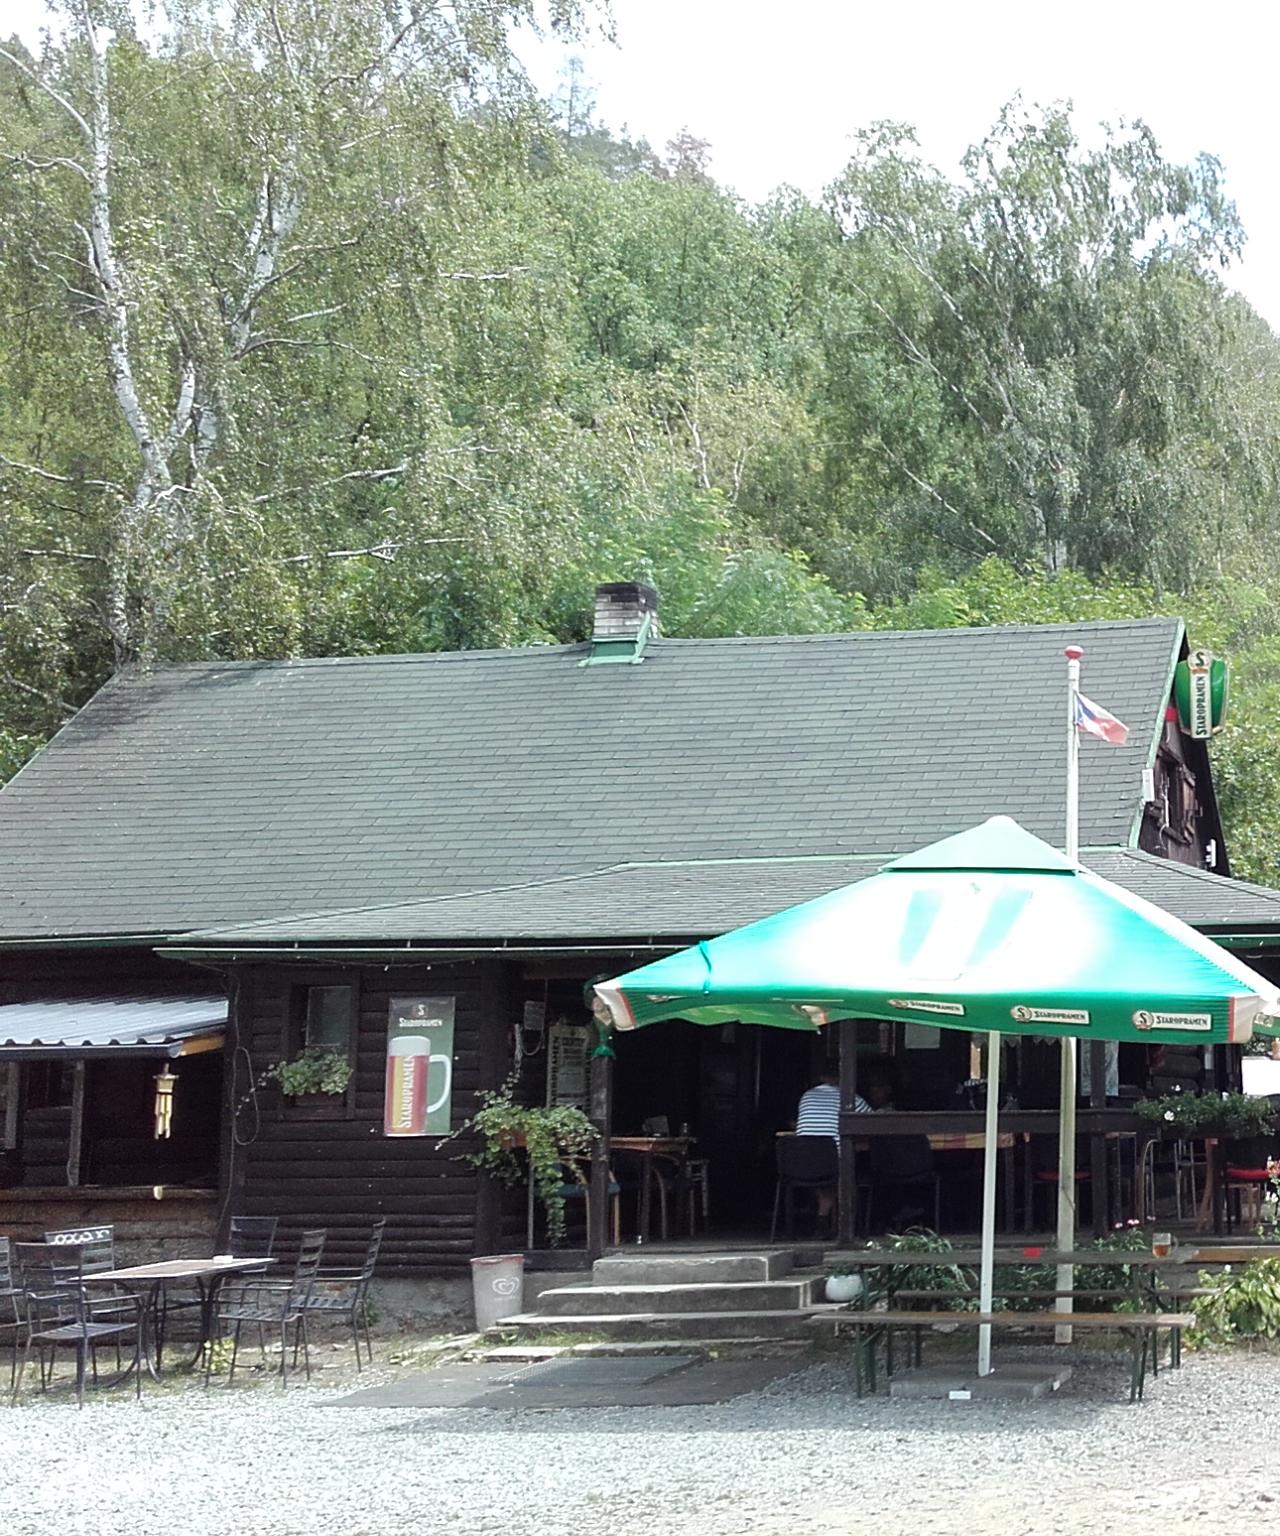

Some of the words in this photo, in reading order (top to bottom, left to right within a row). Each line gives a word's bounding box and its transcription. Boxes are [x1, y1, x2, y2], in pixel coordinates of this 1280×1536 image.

[1195, 676, 1207, 735] STAROPRAMEN
[1034, 1010, 1086, 1021] STAROPRAMEN
[1156, 1015, 1208, 1027] STAROPRAMEN
[398, 1017, 443, 1028] STAROPRAMEN
[398, 1055, 415, 1128] STAROPRAMEN
